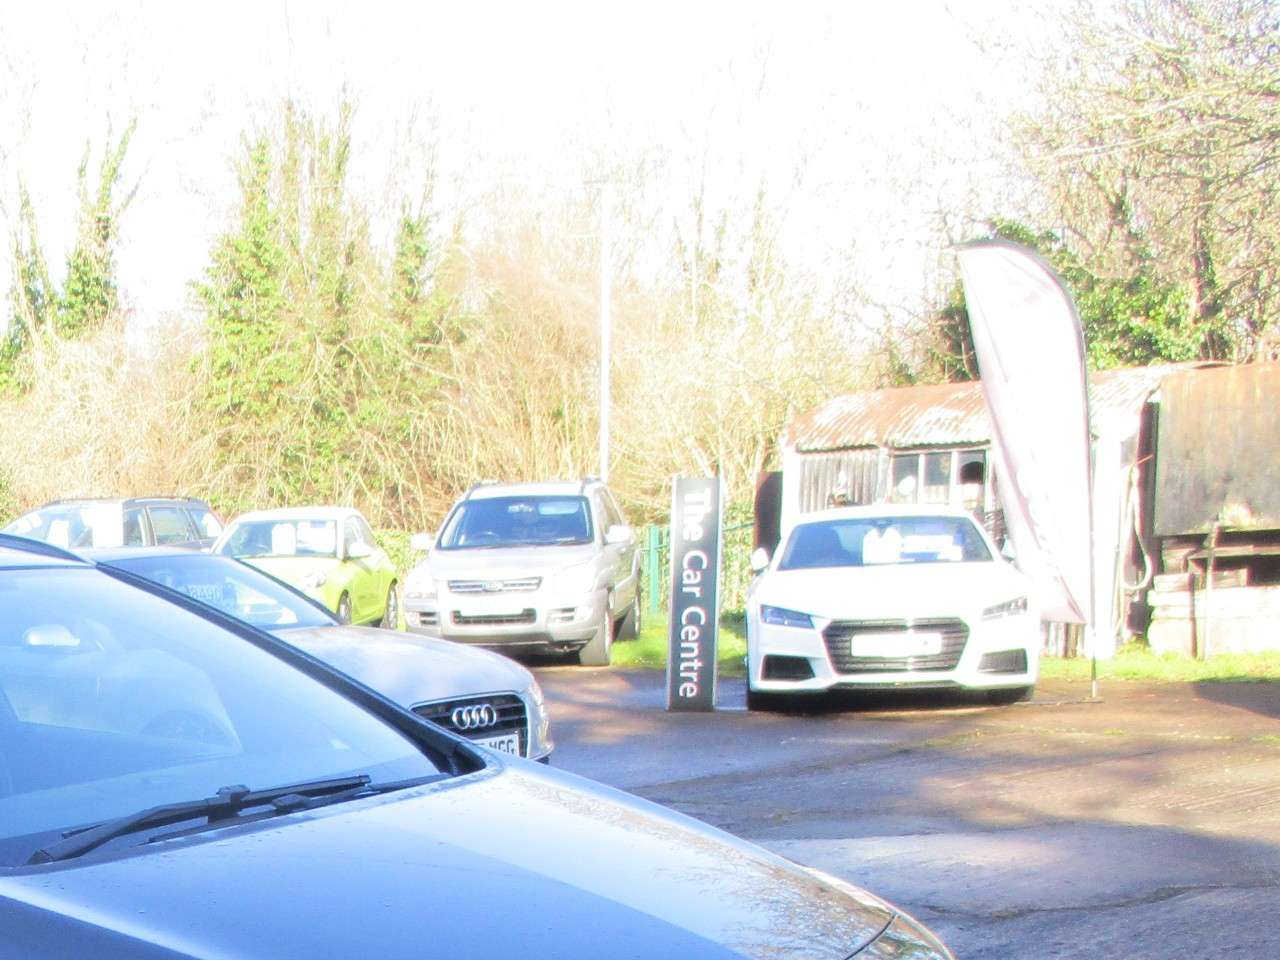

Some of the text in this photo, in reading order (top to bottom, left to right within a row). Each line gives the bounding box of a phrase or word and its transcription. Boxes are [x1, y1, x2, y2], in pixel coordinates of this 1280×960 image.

[679, 487, 712, 699] The Car Centre
